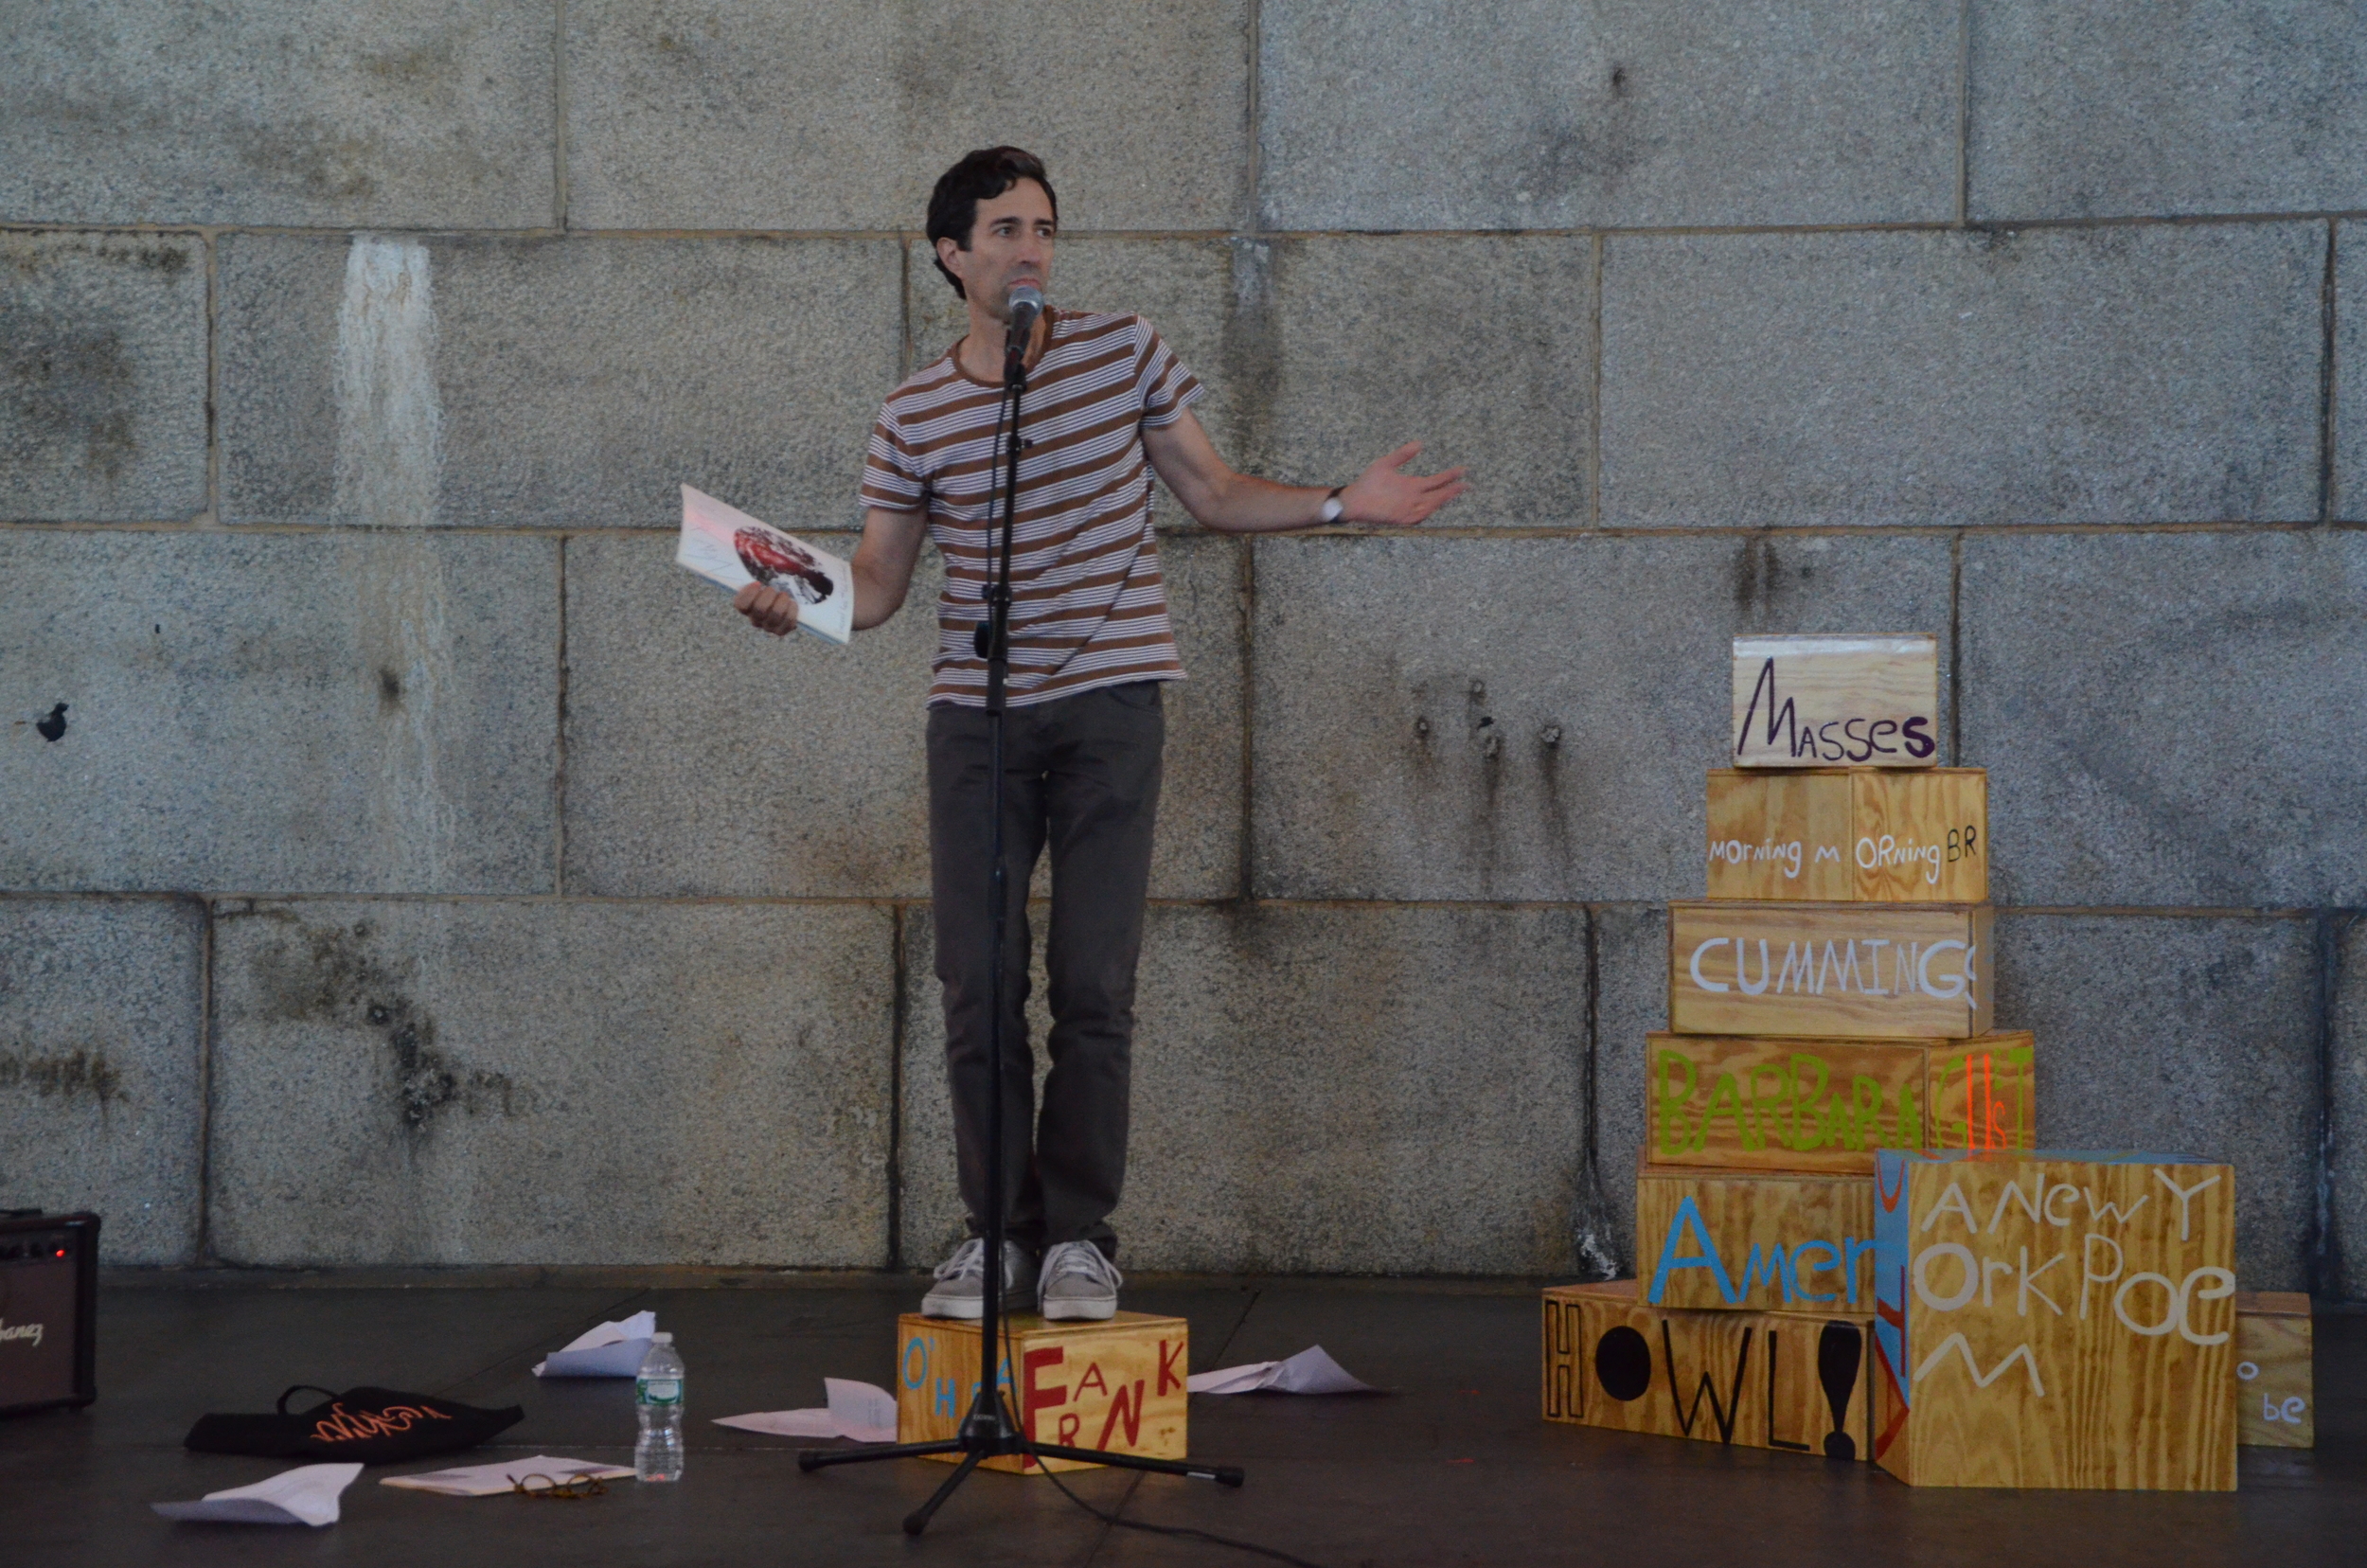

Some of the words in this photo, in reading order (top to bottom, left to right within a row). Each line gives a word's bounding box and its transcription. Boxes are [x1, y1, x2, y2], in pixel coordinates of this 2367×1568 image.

[1920, 1182, 1977, 1234] A
[2152, 1167, 2221, 1242] Y
[1544, 1299, 1861, 1461] HOWL!
[1913, 1331, 2045, 1399] M
[2263, 1392, 2306, 1425] be
